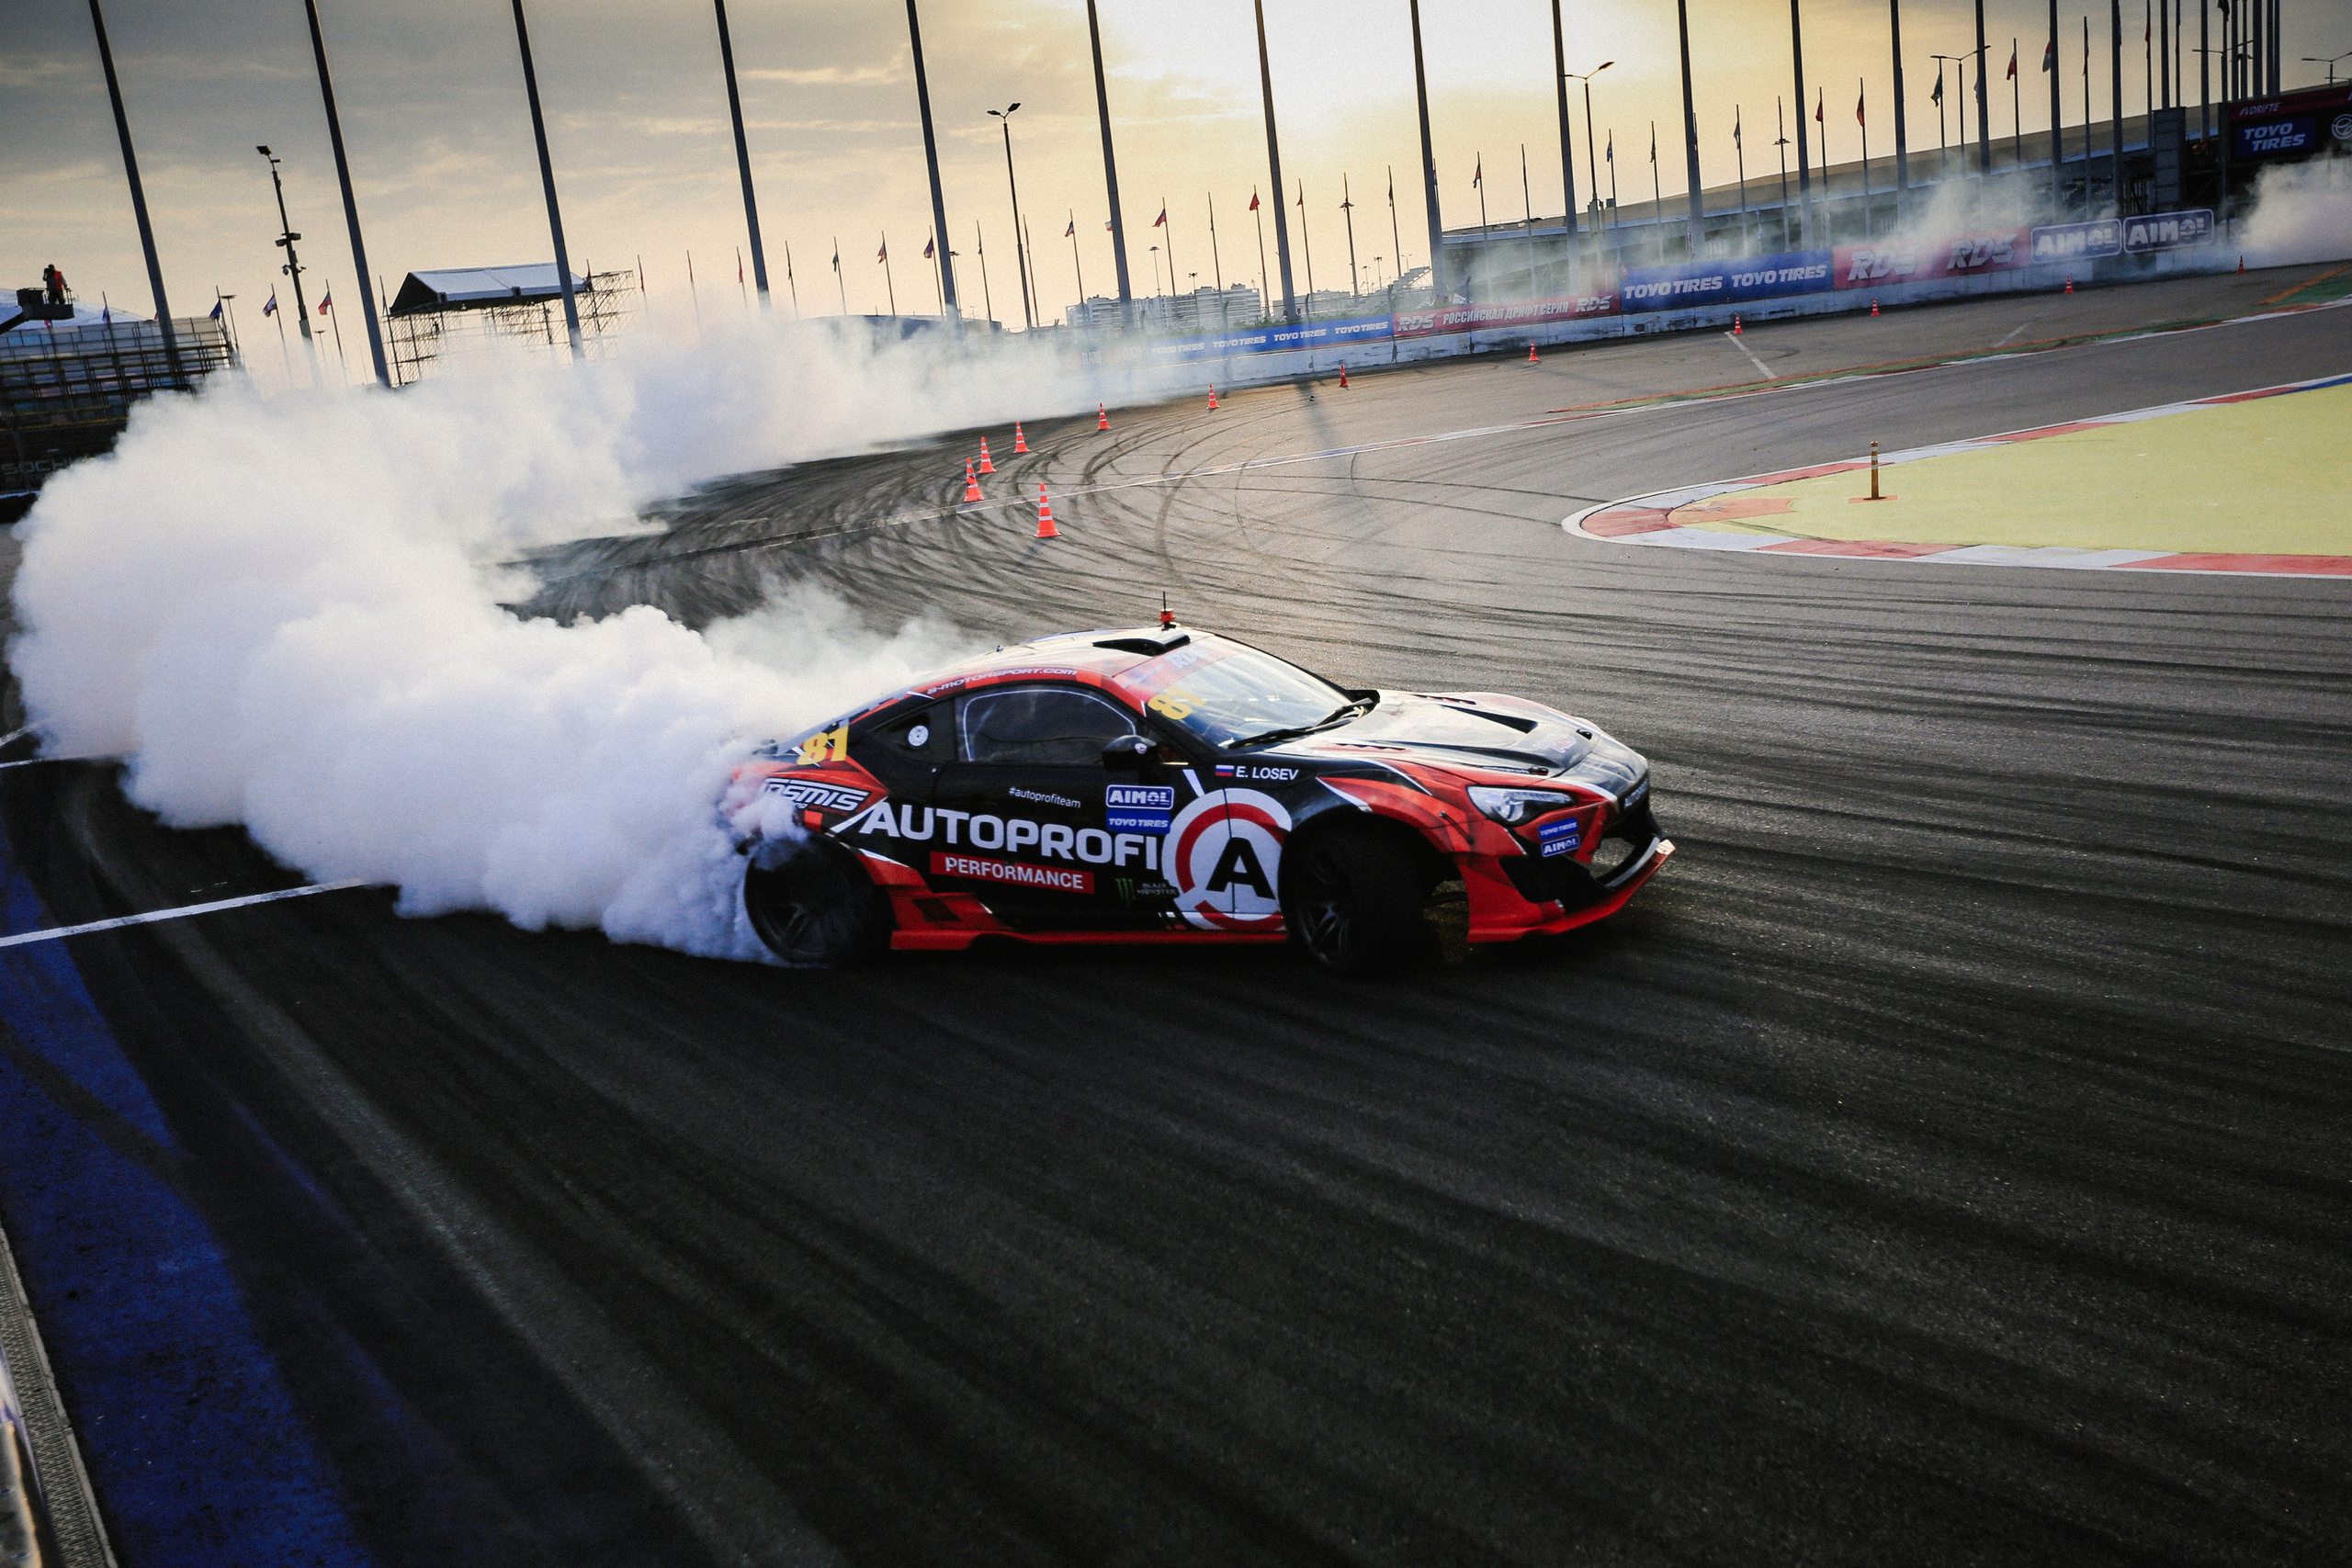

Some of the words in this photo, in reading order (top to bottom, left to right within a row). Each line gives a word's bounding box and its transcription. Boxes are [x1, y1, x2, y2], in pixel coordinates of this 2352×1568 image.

[2244, 122, 2293, 141] TOYO
[2252, 133, 2306, 152] TIRES
[1947, 233, 2019, 270] RDS
[1732, 270, 1777, 288] TOYO
[1779, 265, 1826, 282] TIRES
[1624, 282, 1671, 300] TOYO
[1673, 276, 1724, 294] TIRES
[1442, 307, 1505, 325] РОССИЙСКАЯ
[1505, 304, 1539, 320] ДРИФТ
[1540, 301, 1569, 315] СЕРИЯ
[1575, 295, 1613, 313] RDS
[1335, 325, 1360, 334] TOYO
[1361, 321, 1388, 332] TIRES
[1397, 313, 1436, 332] RDS
[1213, 340, 1238, 348] TOYO
[1239, 335, 1266, 345] TIRES
[1273, 333, 1299, 342] TOYO
[1300, 329, 1327, 338] TIRES
[797, 718, 850, 765] 81
[1236, 766, 1249, 778] E.
[1251, 767, 1299, 781] LOSEV
[1009, 786, 1080, 808] #autoprofiteam
[1109, 790, 1170, 805] AIMOL
[1108, 818, 1137, 827] TOYO
[1138, 819, 1169, 829] TIRES
[858, 801, 1158, 871] AUTOPROFI
[944, 856, 1083, 889] PERFORMANCE
